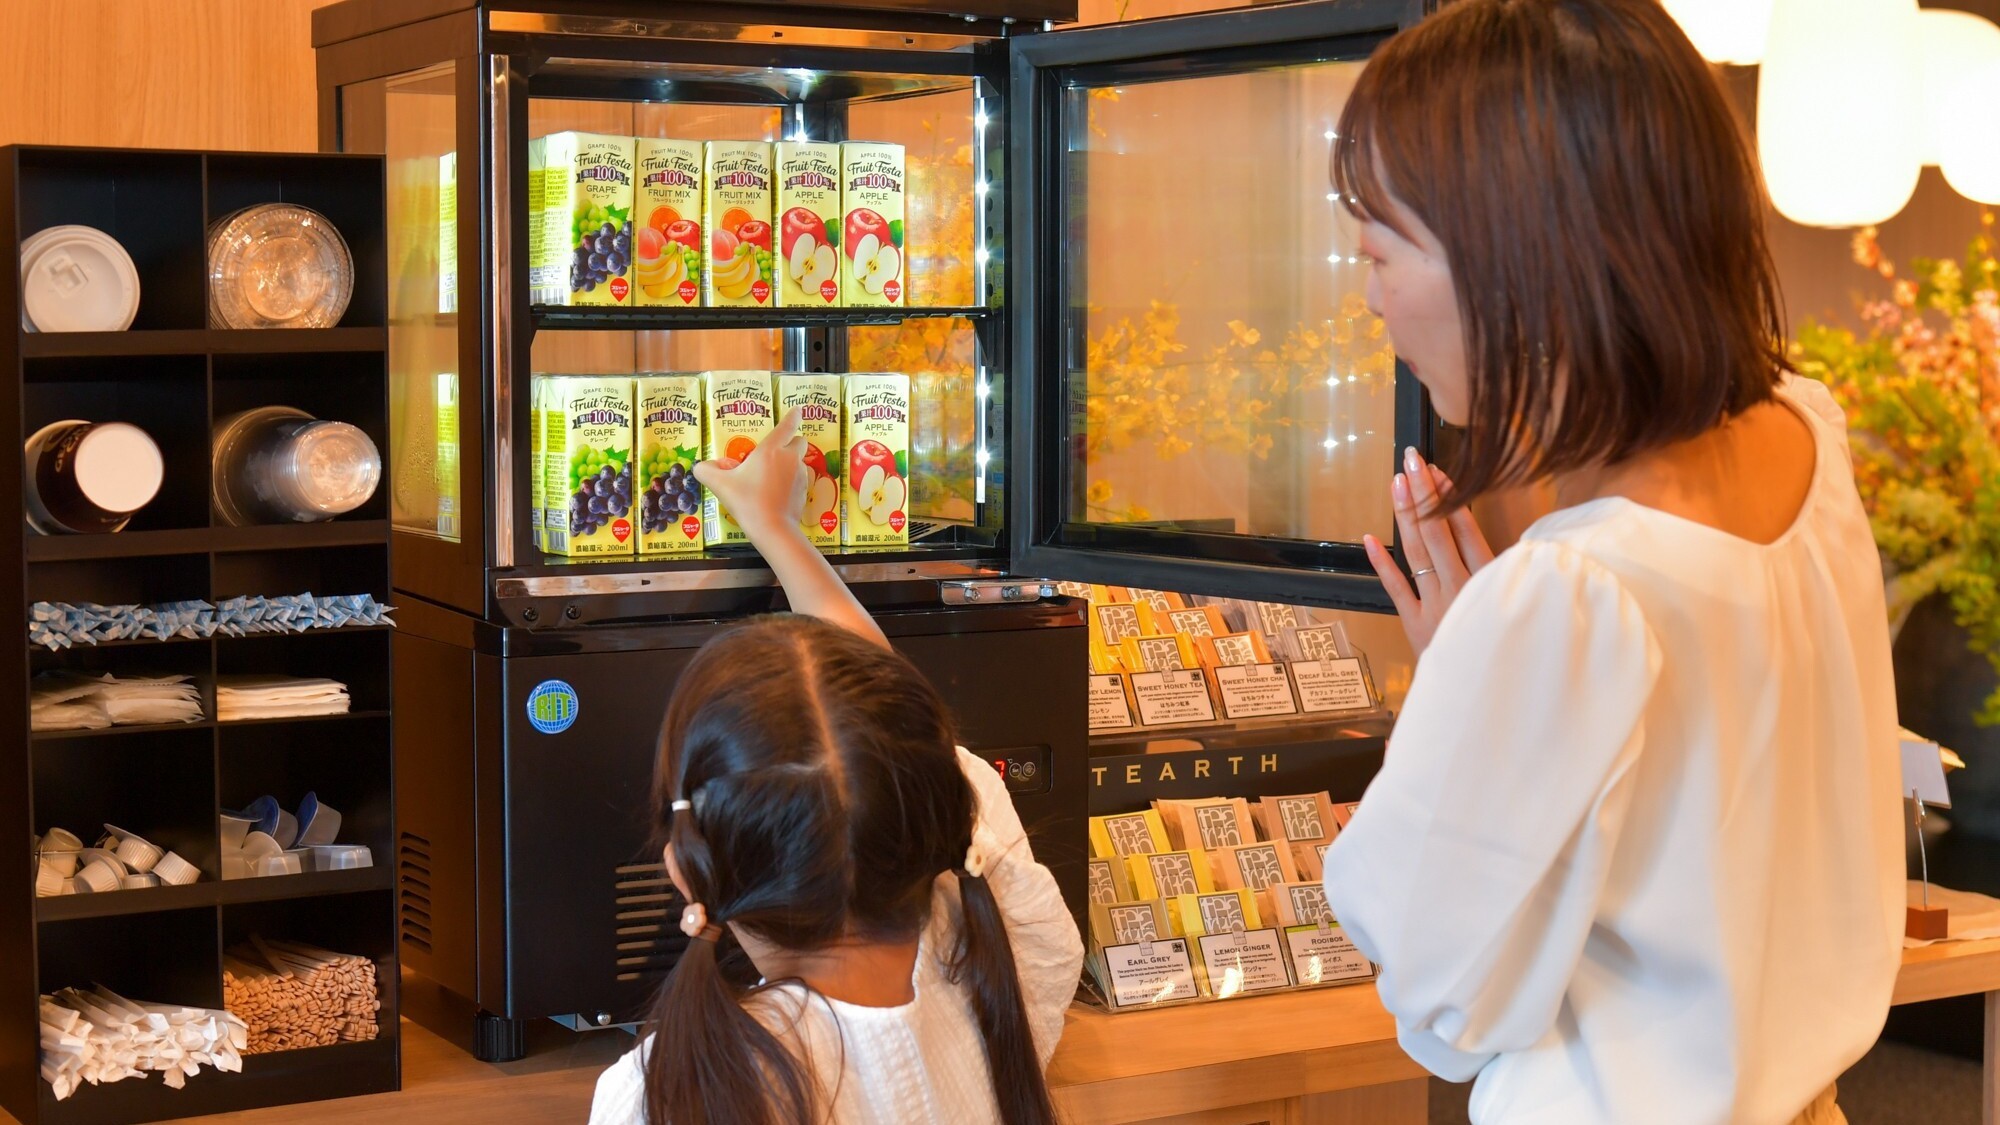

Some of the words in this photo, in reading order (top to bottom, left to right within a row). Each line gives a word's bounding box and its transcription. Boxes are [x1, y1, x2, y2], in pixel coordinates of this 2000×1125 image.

[608, 144, 622, 152] 100%
[679, 148, 694, 158] 100%
[747, 152, 762, 160] 100%
[878, 152, 892, 160] 100%
[574, 152, 603, 166] Fruit
[603, 152, 632, 170] Festa
[642, 156, 670, 171] Fruit
[670, 156, 699, 174] Festa
[712, 158, 740, 174] Fruit
[740, 158, 769, 176] Festa
[782, 158, 809, 174] Fruit
[809, 158, 838, 176] Festa
[847, 160, 874, 174] Fruit
[874, 160, 902, 178] Festa
[586, 184, 617, 194] GRAPE
[648, 189, 673, 198] FRUIT
[674, 190, 690, 198] MIX
[719, 191, 744, 199] FRUIT
[860, 192, 888, 200] APPLE
[721, 380, 736, 388] FRUIT
[748, 378, 764, 388] 100%
[604, 387, 619, 395] 100%
[654, 386, 671, 394] GRAPE
[673, 386, 687, 394] 100%
[712, 386, 741, 403] Fruit
[742, 386, 771, 403] Festa
[570, 396, 600, 412] Fruit
[600, 396, 631, 412] Festa
[640, 395, 669, 411] Fruit
[669, 394, 699, 411] Festa
[782, 392, 810, 408] Fruit
[810, 392, 839, 408] Festa
[852, 392, 878, 408] Fruit
[878, 392, 908, 408] Festa
[802, 404, 830, 420] 100%
[584, 428, 616, 437] GRAPE
[654, 427, 685, 435] GRAPE
[884, 534, 904, 542] 200ml
[607, 544, 628, 552] 200ml
[678, 541, 698, 549] 200ml
[1222, 678, 1245, 686] SWEET
[1137, 684, 1162, 692] SWEET
[535, 692, 572, 722] RIT
[1092, 754, 1277, 786] TEARTH
[1312, 936, 1344, 945] ROOIBOS
[1214, 948, 1241, 956] LEMON
[1242, 944, 1271, 952] GINGER
[1150, 956, 1171, 964] GREY
